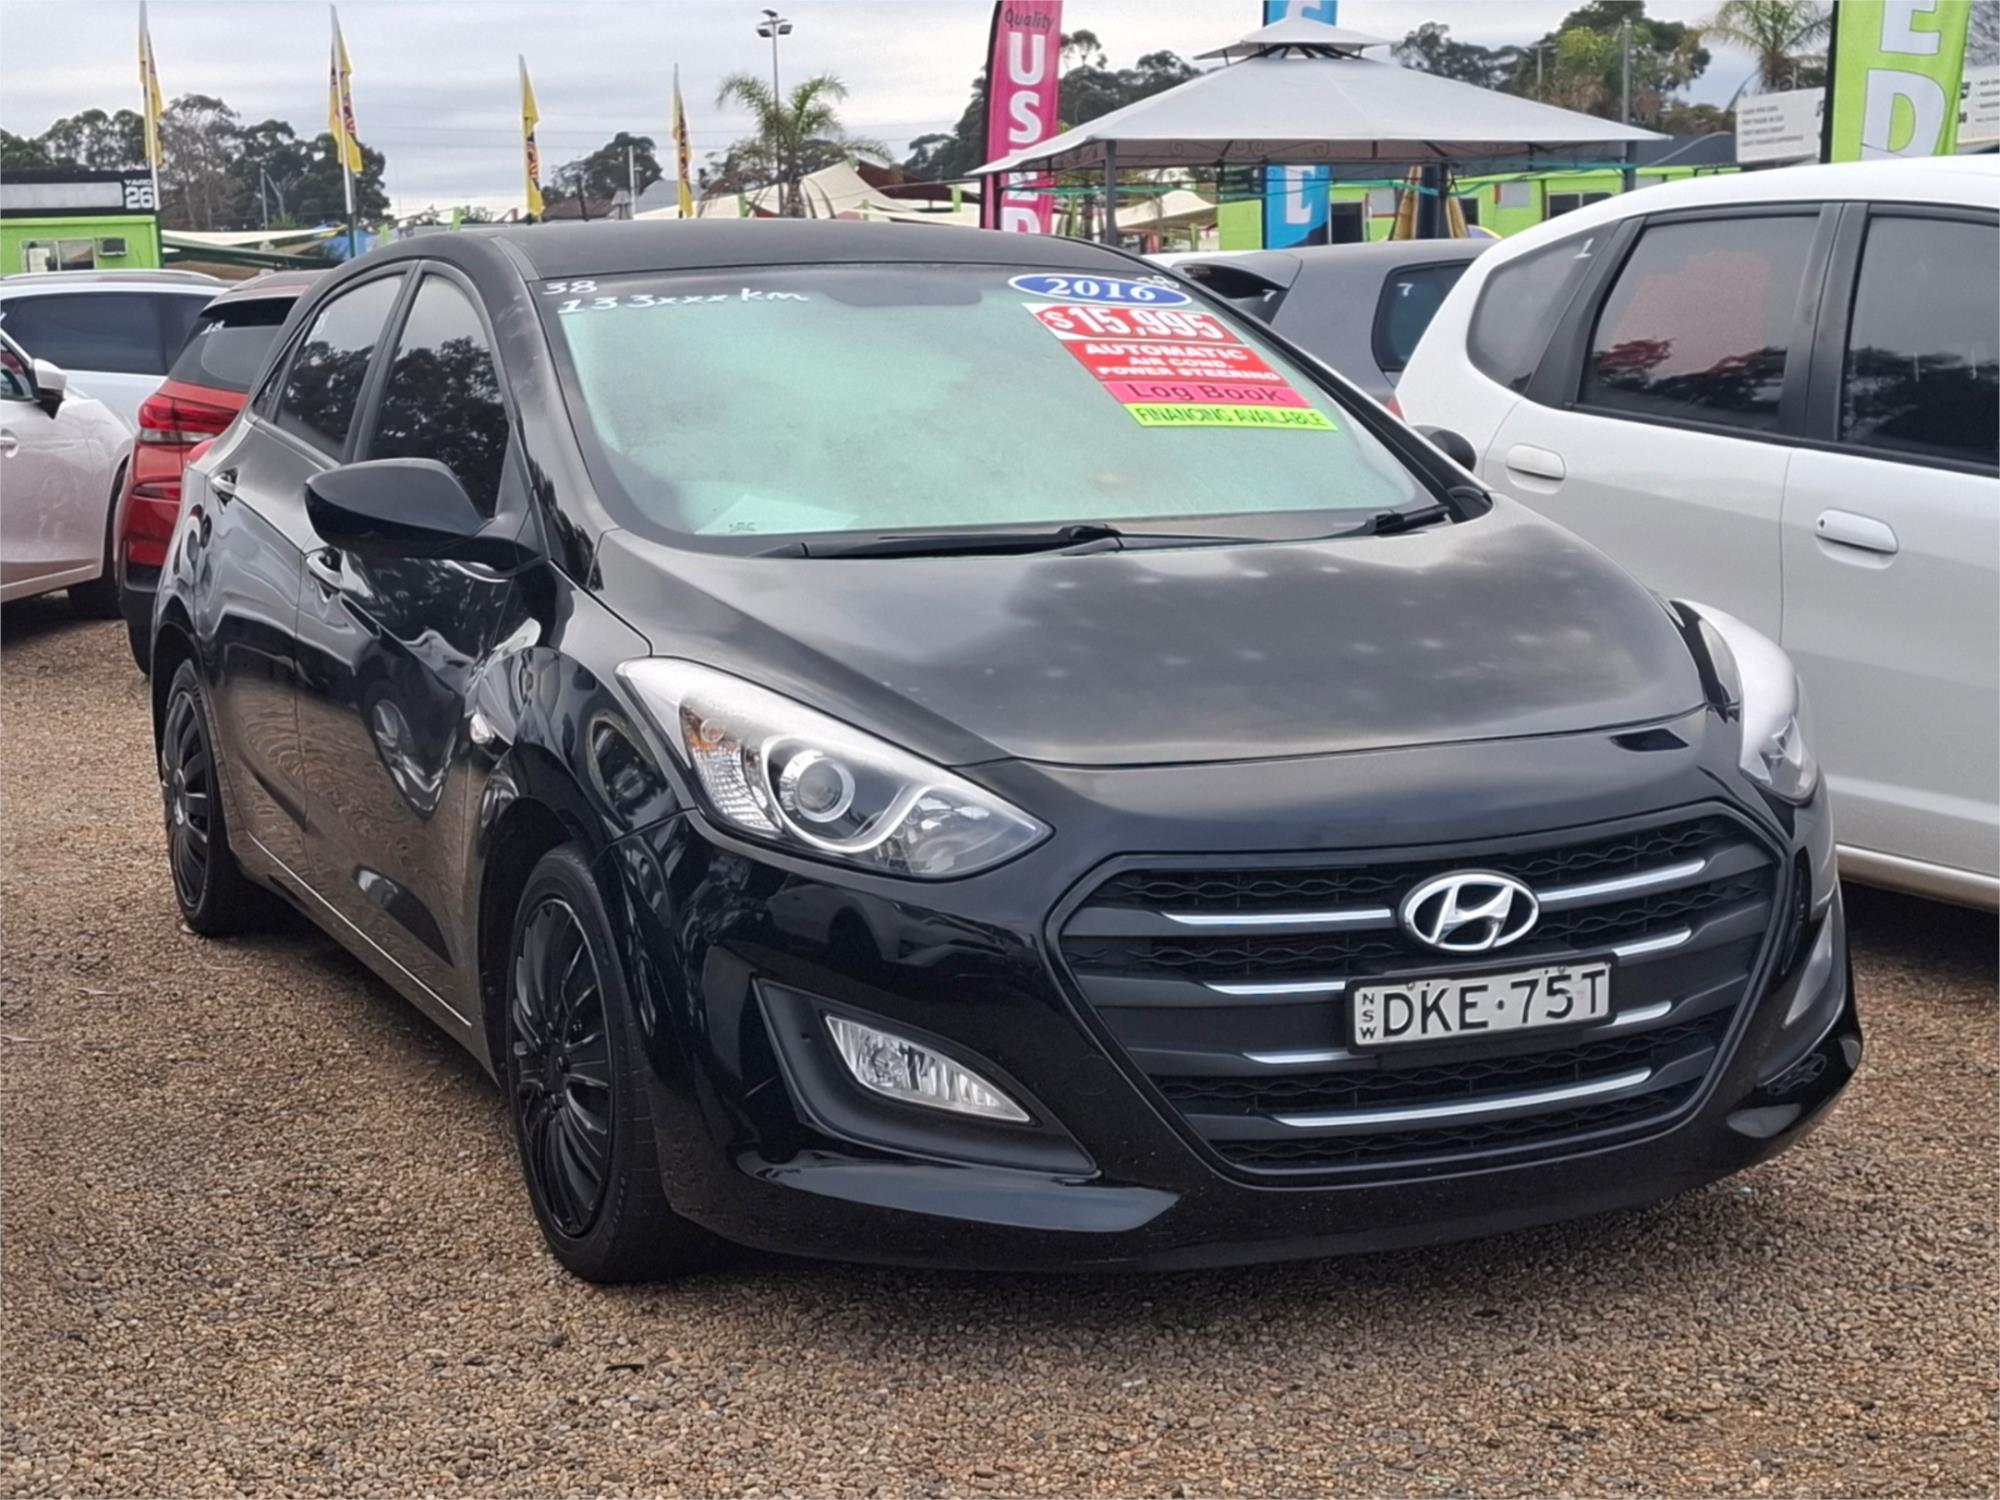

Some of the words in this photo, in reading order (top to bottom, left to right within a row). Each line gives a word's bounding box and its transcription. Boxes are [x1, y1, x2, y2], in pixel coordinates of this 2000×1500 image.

[1004, 7, 1055, 34] Quality
[125, 186, 154, 209] 26
[541, 280, 598, 295] 38
[1044, 277, 1156, 301] 2016
[1043, 306, 1224, 339] $15,995
[1085, 343, 1249, 361] AUTOMATIC
[1129, 356, 1168, 367] AIR
[1096, 366, 1176, 376] POWER
[1176, 367, 1282, 382] STEERING
[1126, 383, 1195, 401] Log
[1203, 385, 1287, 402] Book
[1135, 407, 1232, 423] FINANCING
[1239, 408, 1330, 426] AVAILABLE
[1359, 992, 1377, 1040] NSW
